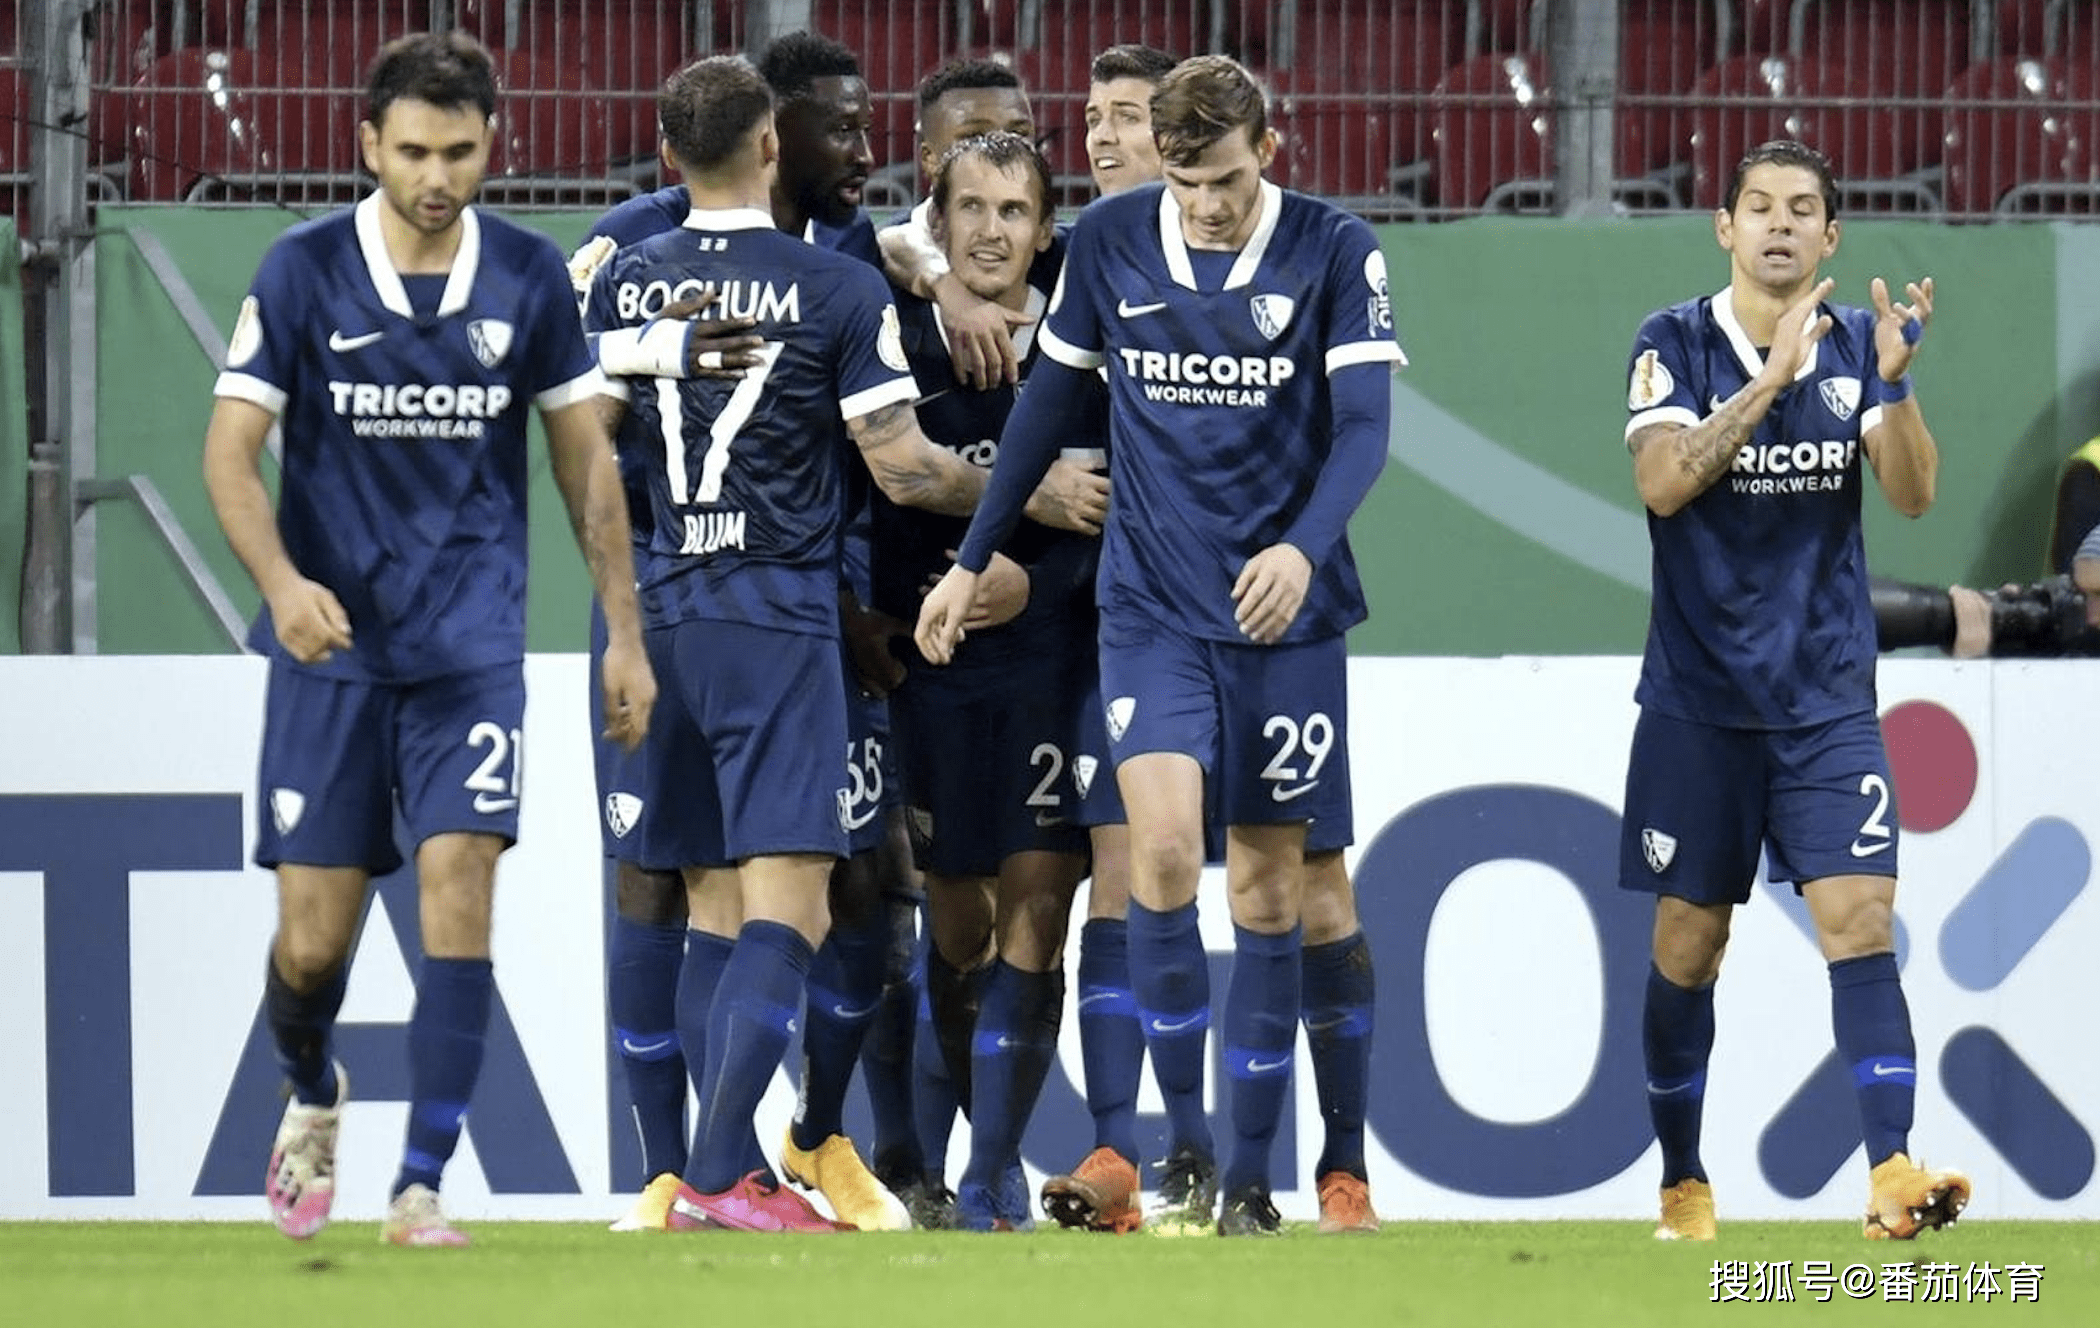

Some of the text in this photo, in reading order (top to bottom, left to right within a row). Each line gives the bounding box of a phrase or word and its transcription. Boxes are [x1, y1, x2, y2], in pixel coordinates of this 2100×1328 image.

[1119, 347, 1295, 387] TRICORP
[328, 380, 513, 419] TRICORP
[1143, 384, 1268, 408] WORKWEAR
[351, 418, 486, 439] WORKWEAR
[653, 340, 785, 504] 17
[1731, 439, 1857, 474] RICOR
[679, 510, 746, 555] BLUM
[463, 720, 522, 798] 21
[1259, 711, 1335, 780] 29
[1025, 742, 1064, 806] 2
[1859, 773, 1891, 838] 2
